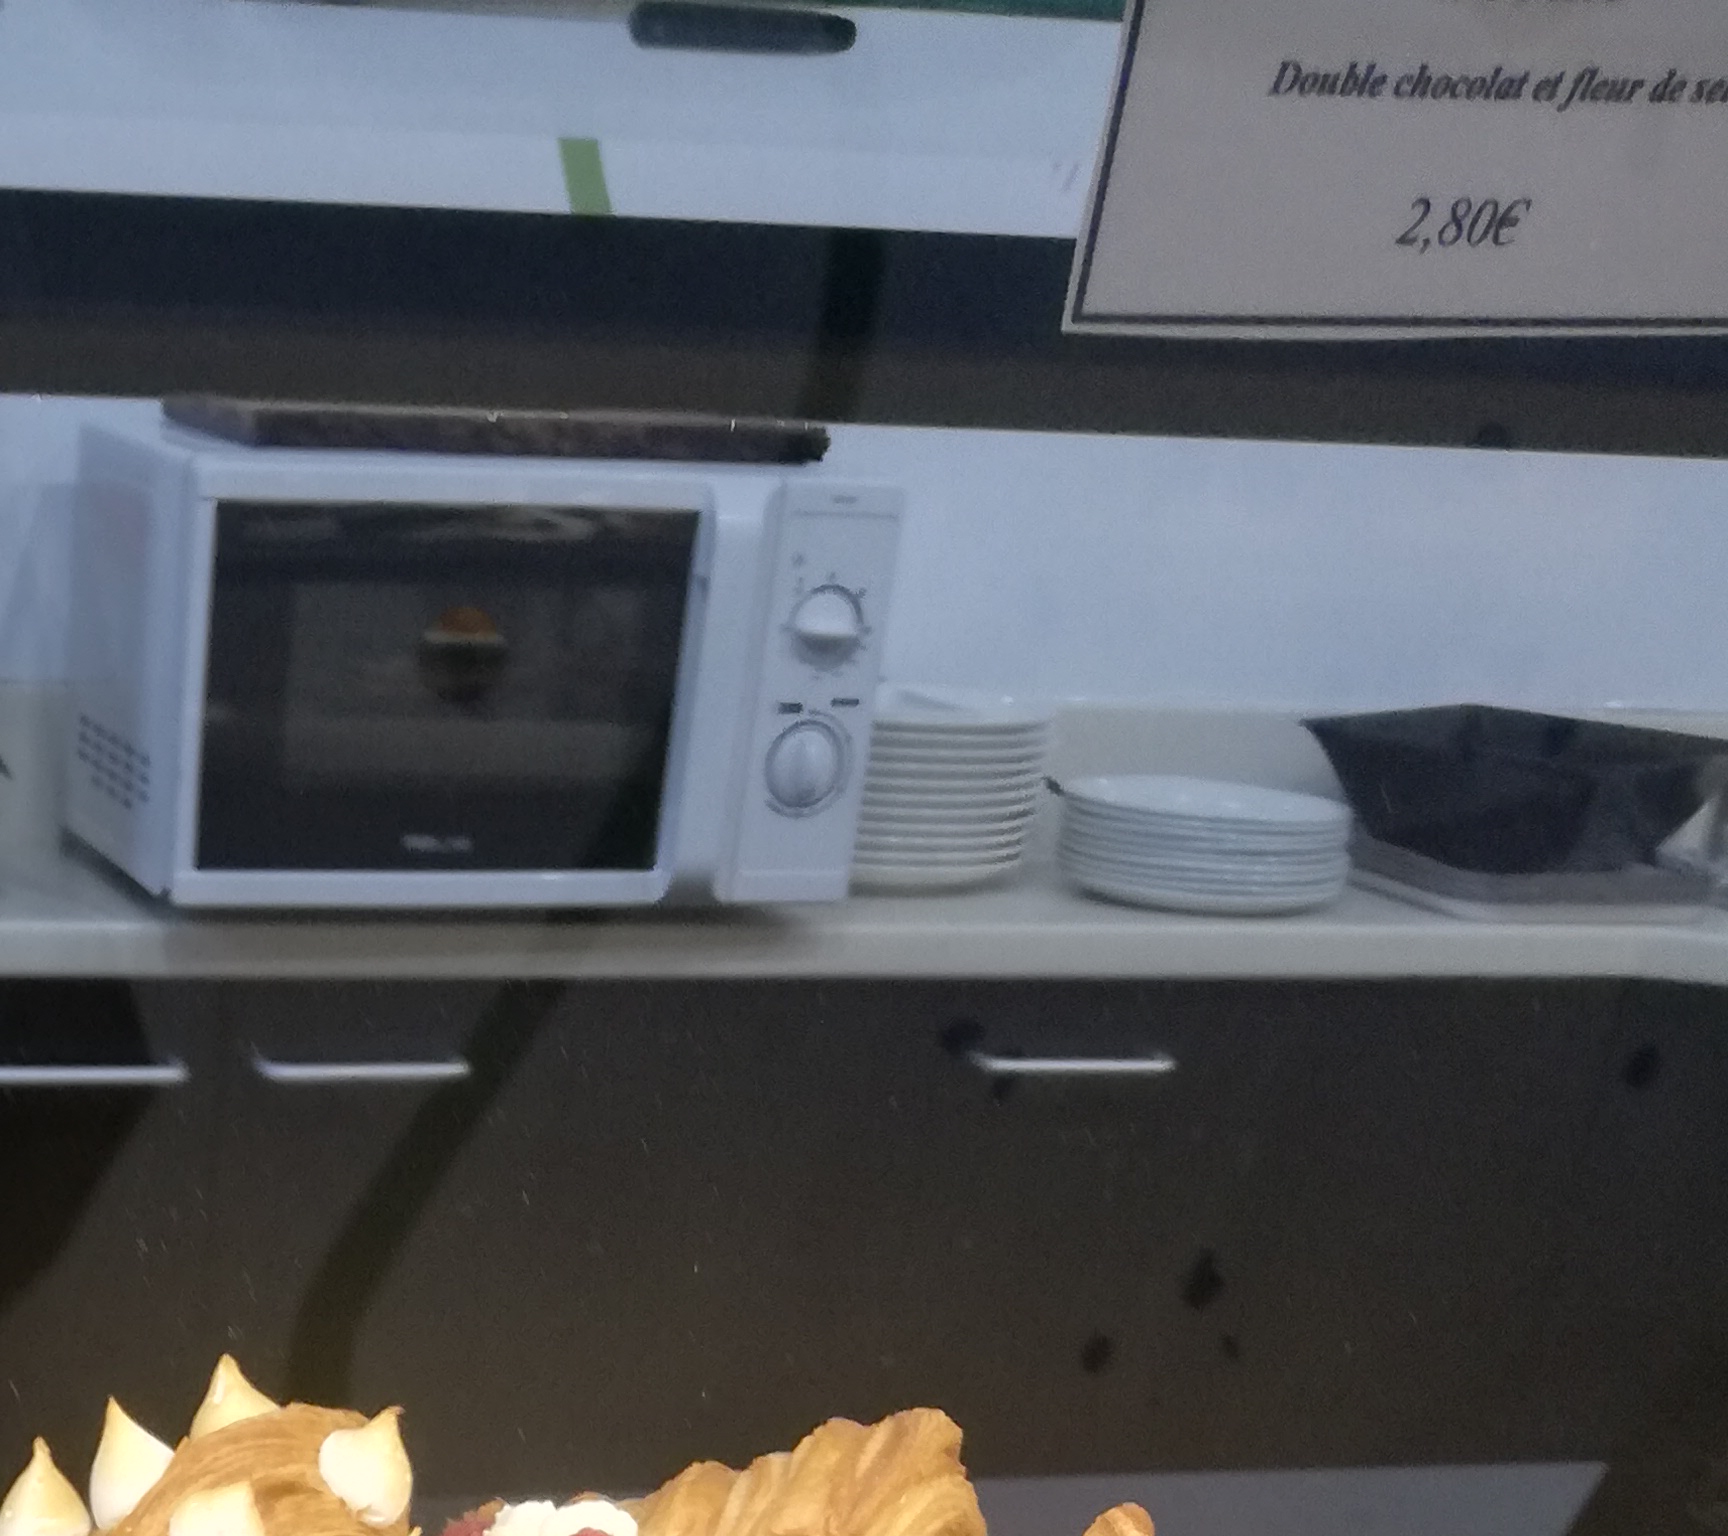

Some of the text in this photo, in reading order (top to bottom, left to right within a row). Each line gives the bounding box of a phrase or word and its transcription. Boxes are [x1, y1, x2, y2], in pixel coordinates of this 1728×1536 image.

[1268, 59, 1387, 98] Double
[1393, 63, 1530, 101] chocolat
[1531, 70, 1565, 102] et
[1556, 66, 1645, 112] fleur
[1649, 68, 1688, 103] de
[1395, 197, 1531, 254] 2,80€
